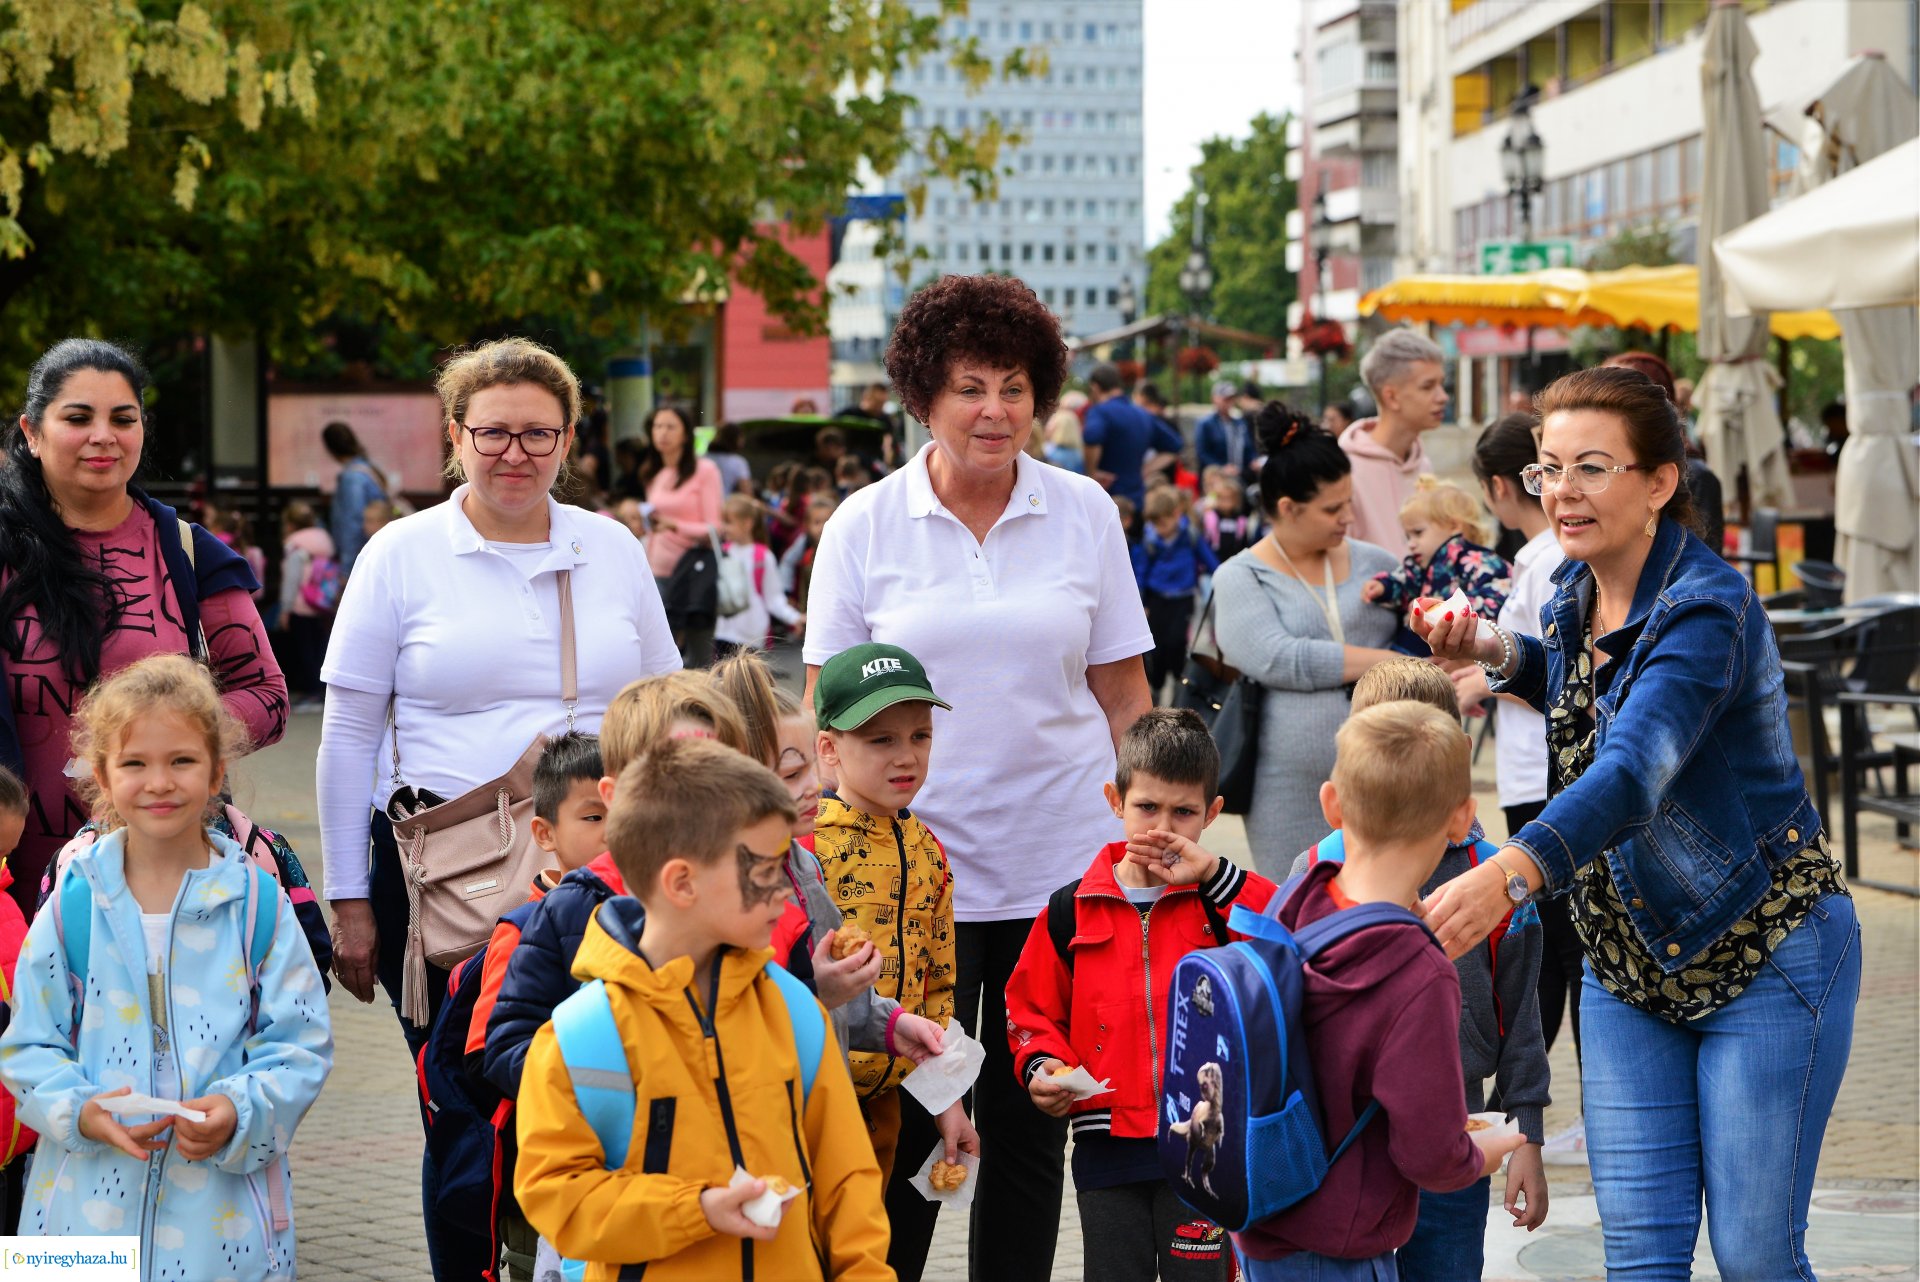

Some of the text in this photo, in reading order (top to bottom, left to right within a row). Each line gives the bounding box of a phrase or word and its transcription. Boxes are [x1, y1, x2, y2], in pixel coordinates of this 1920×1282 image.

[861, 657, 902, 678] KITE
[1173, 990, 1190, 1076] T-REX
[1171, 1242, 1222, 1251] LIGHTNING
